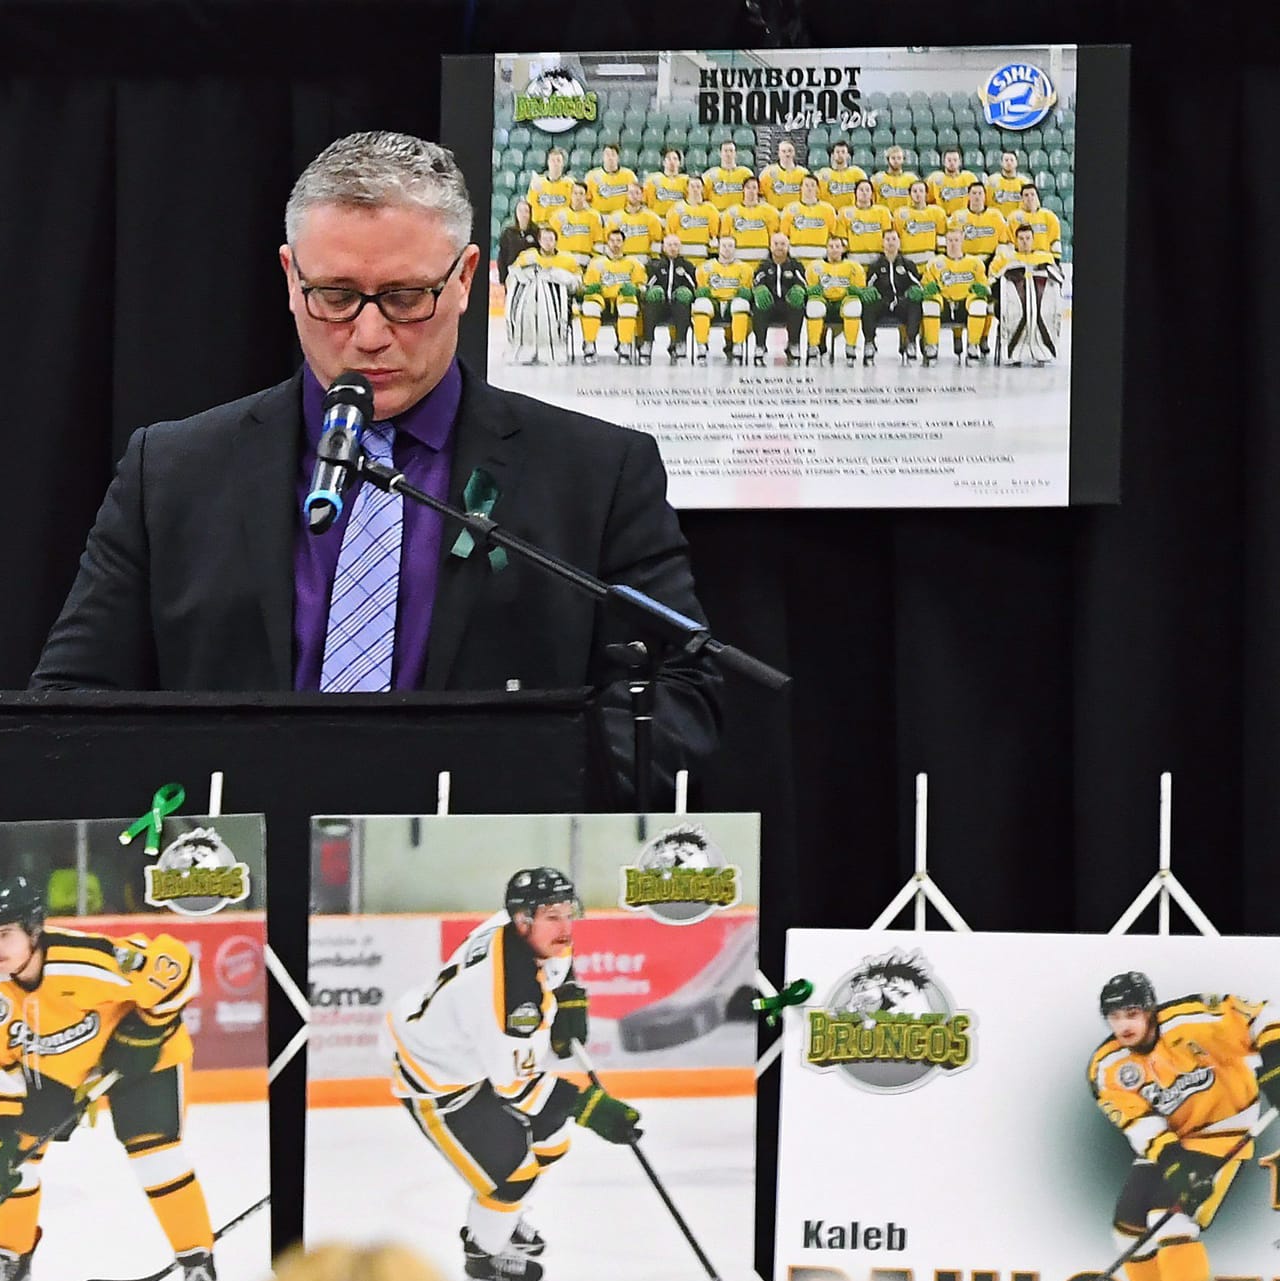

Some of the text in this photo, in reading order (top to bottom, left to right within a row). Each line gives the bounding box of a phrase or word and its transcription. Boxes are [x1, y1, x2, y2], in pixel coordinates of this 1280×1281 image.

[699, 66, 862, 88] HUMBOLDT
[698, 89, 862, 125] BRONCOS
[148, 954, 183, 990] 13
[807, 1011, 971, 1066] BRONCOS
[802, 1219, 907, 1253] Kaleb
